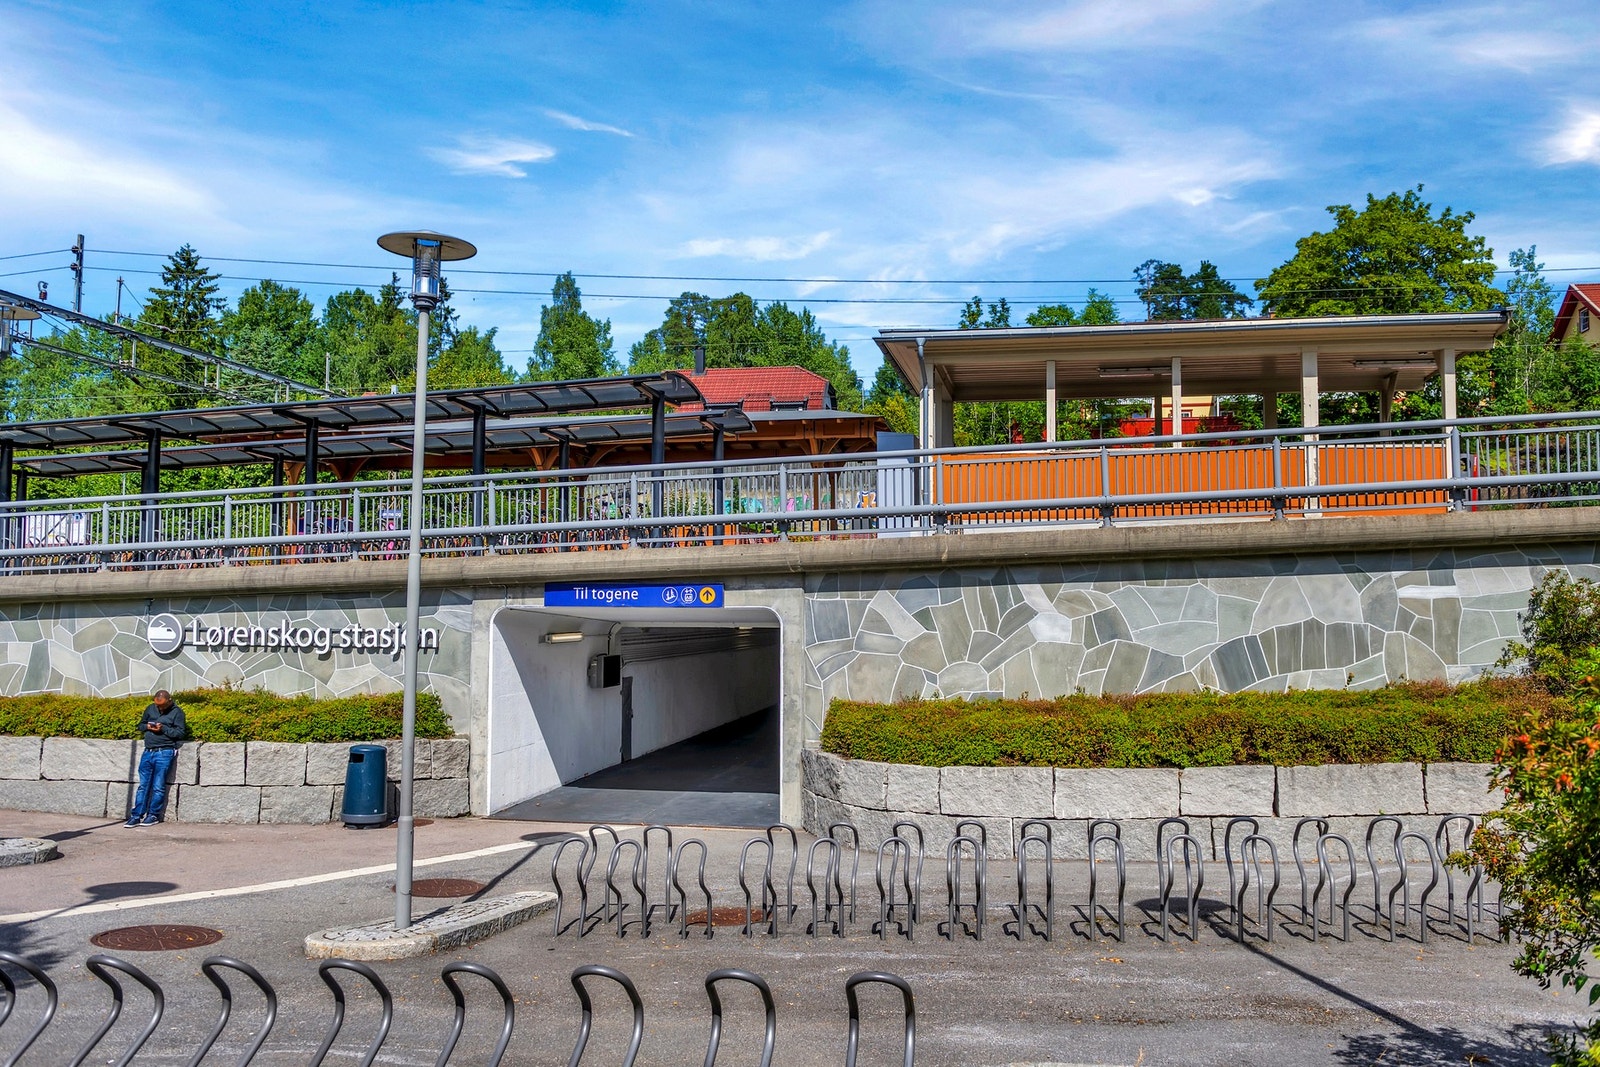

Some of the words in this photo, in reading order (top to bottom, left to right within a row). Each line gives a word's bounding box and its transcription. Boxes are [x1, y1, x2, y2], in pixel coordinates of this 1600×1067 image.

[573, 586, 588, 600] Til
[591, 588, 639, 603] togene
[193, 619, 330, 655] Lørenskog
